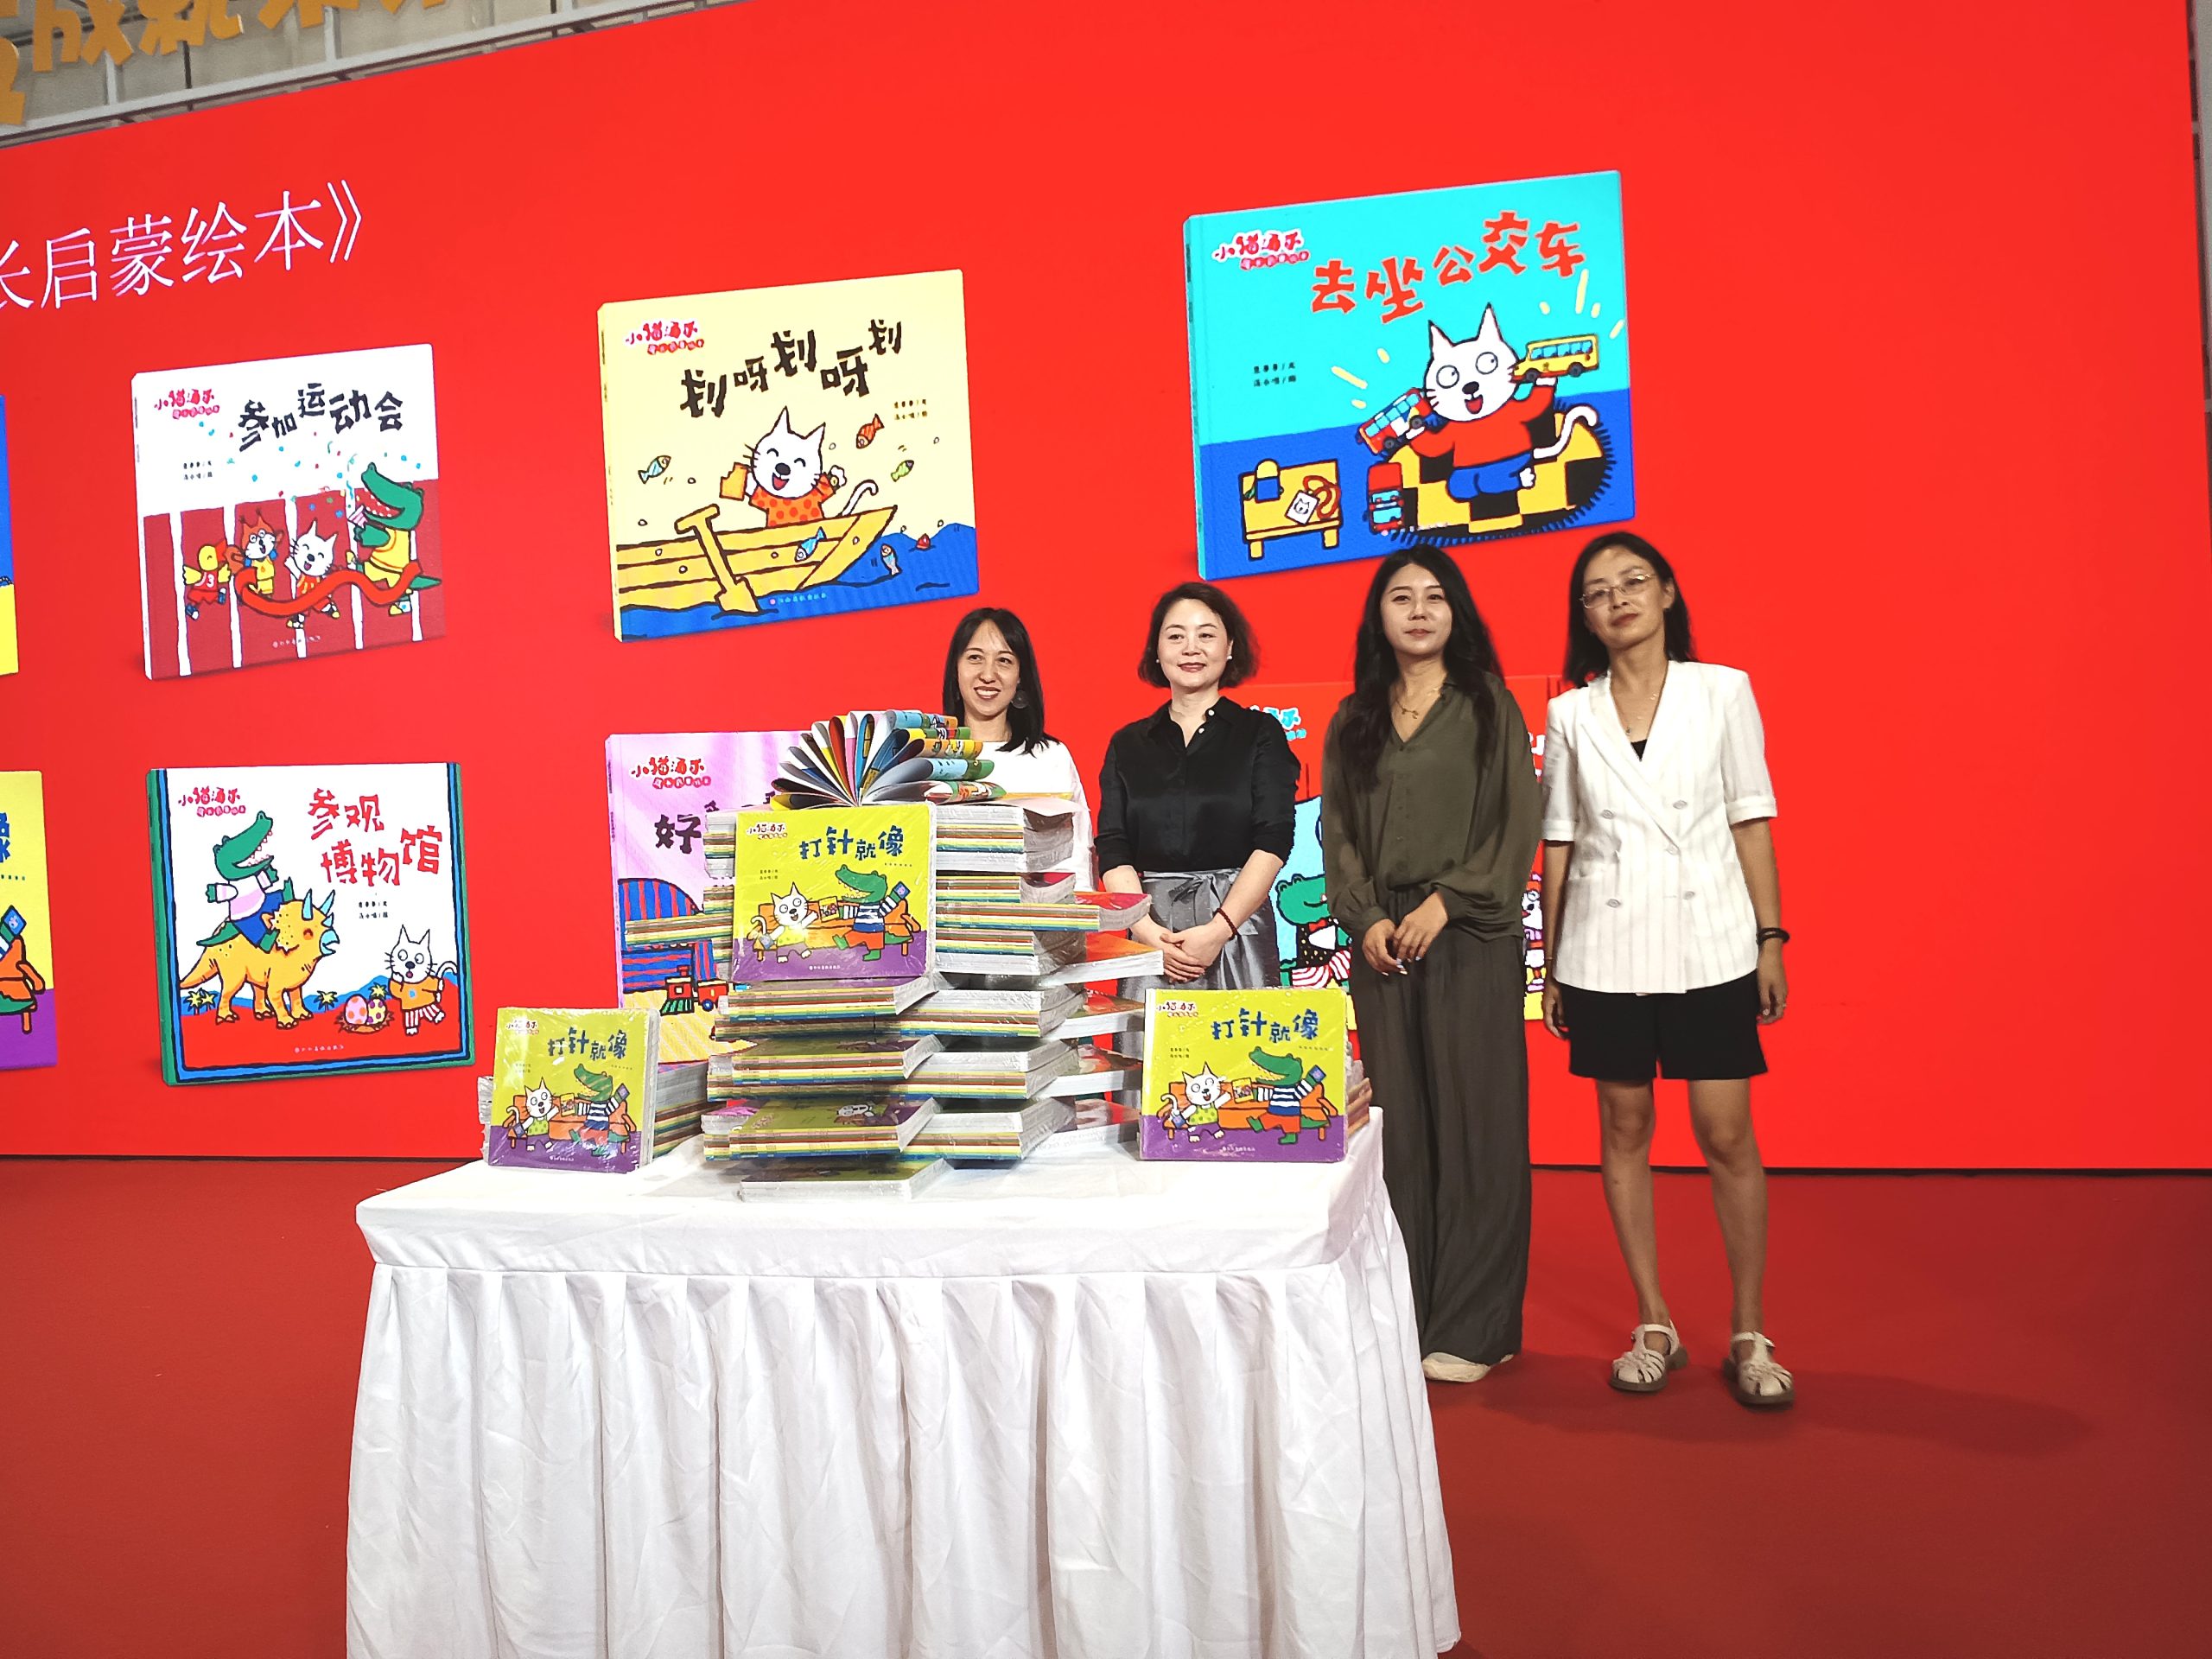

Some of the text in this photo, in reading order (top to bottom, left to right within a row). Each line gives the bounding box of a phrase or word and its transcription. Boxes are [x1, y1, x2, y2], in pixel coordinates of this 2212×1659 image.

[1311, 210, 1585, 324] 去坐公交车
[679, 319, 902, 418] 划呀划呀划
[238, 382, 404, 452] 参加运动会
[307, 788, 385, 840] 参观
[321, 825, 442, 887] 博物馆
[799, 825, 904, 861] 打针就像
[547, 1027, 627, 1061] 打针就像
[1211, 1007, 1319, 1043] 打针就像
